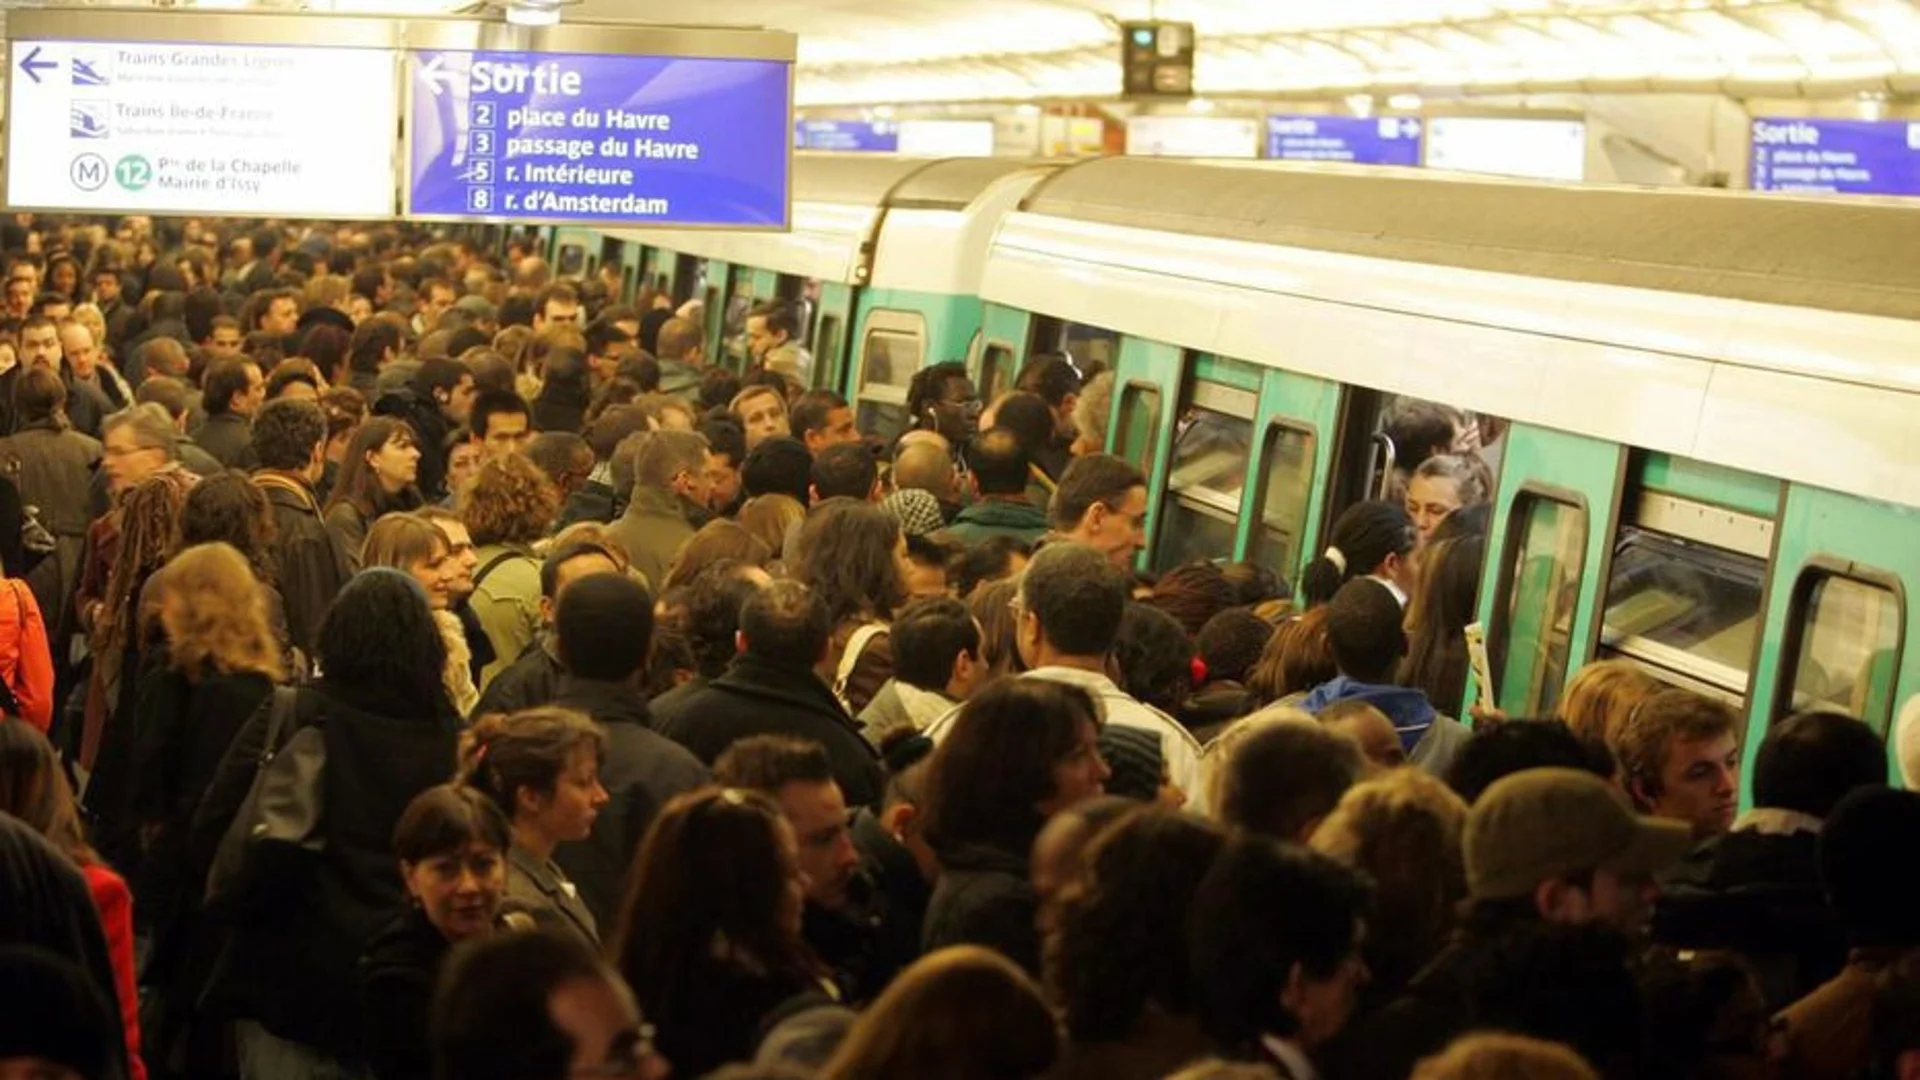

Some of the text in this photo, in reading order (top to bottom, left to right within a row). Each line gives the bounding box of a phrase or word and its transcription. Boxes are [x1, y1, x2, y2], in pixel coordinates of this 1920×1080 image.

[471, 61, 582, 95] Sortie
[476, 106, 670, 130] 2 place du Havre
[1753, 121, 1820, 145] Sortie
[475, 134, 699, 160] 3 passage du Havre
[118, 160, 147, 185] 12
[185, 158, 206, 173] de
[211, 159, 226, 173] la
[231, 159, 301, 175] Chapelle
[475, 163, 633, 184] 5 r. Intérieure
[158, 176, 211, 190] Mairie
[474, 190, 669, 214] 8 r. d'Amsterdam
